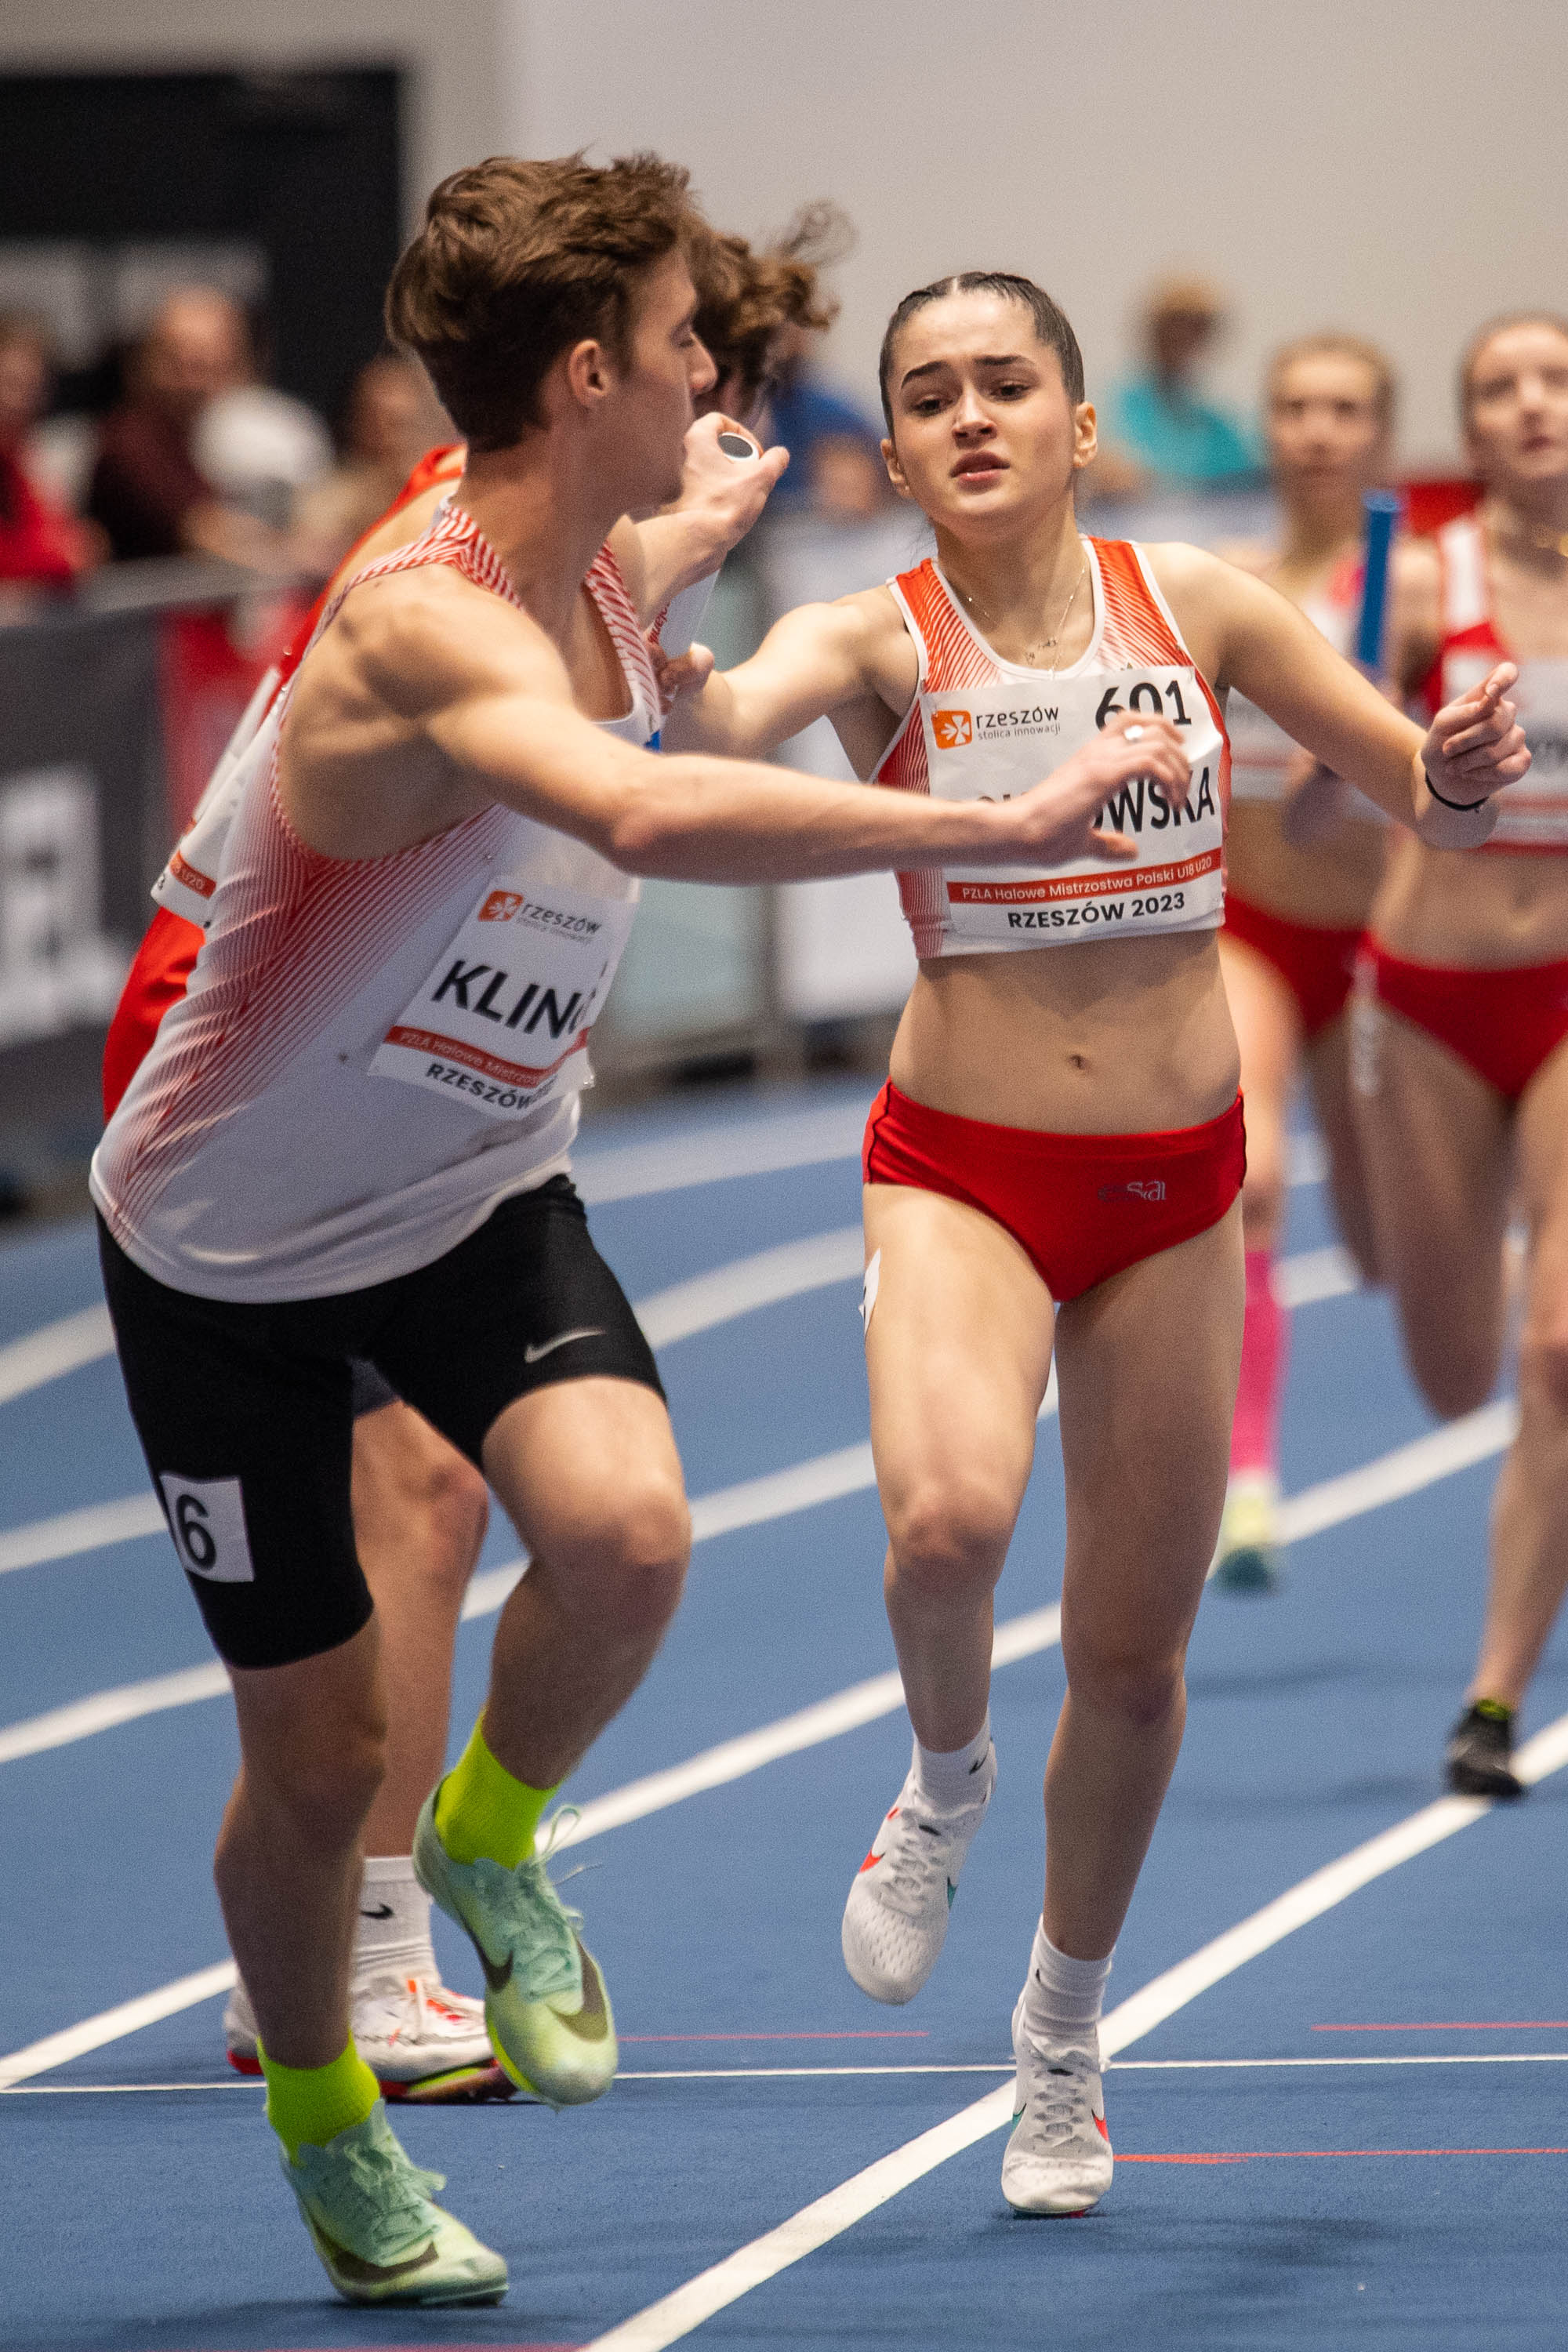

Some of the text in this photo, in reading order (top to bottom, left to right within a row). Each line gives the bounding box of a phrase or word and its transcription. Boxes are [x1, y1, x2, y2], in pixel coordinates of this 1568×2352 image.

[976, 706, 1058, 728] rzeszów
[1095, 680, 1192, 732] 601
[978, 722, 1060, 740] stolica innowacji
[963, 856, 1212, 900] PZLA Halowe Mistrzostwa Polski U18 U20
[1007, 892, 1185, 928] RZESZÓW 2023
[431, 960, 596, 1039] KLIN
[176, 1494, 217, 1570] 6
